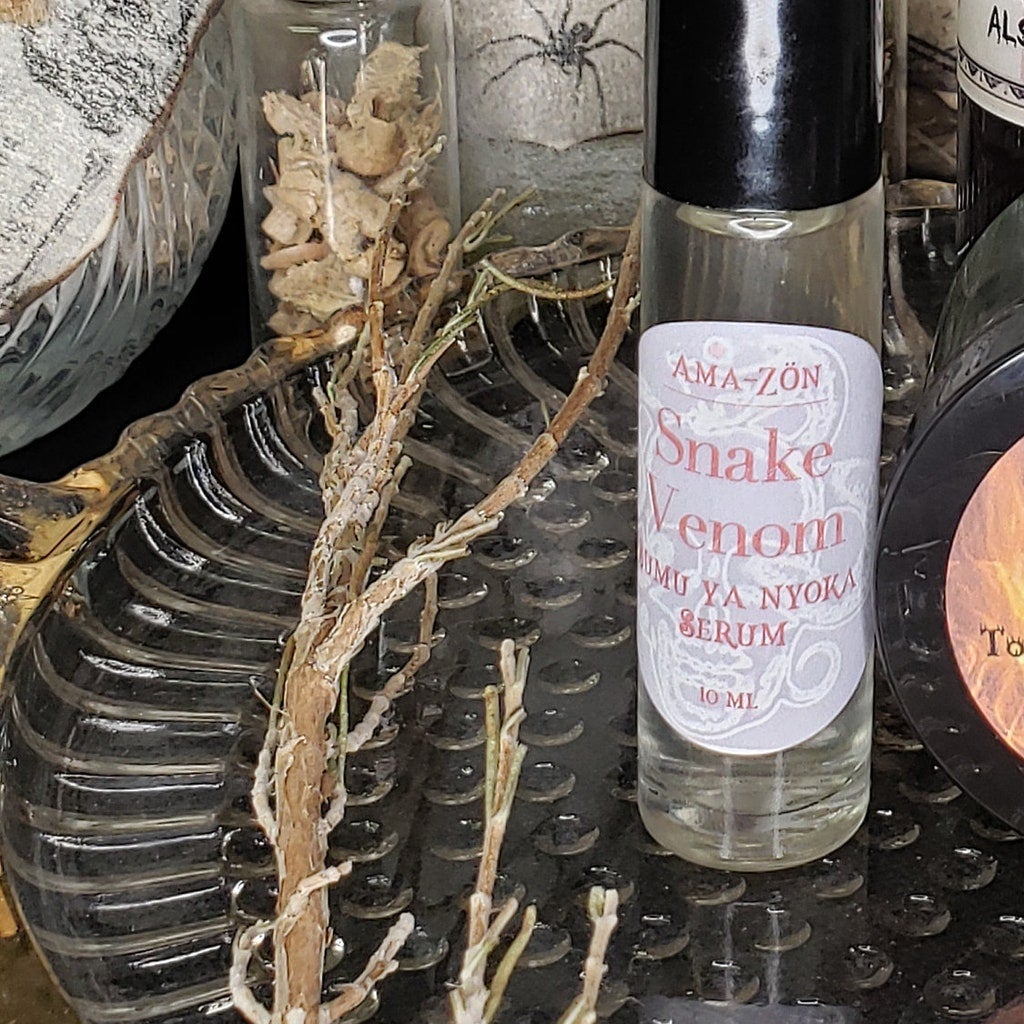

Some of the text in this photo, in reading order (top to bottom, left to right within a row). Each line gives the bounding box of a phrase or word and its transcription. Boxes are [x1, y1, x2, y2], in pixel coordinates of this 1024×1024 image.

[672, 354, 821, 396] AMA-ZÖN
[655, 407, 833, 484] Snake
[648, 472, 847, 558] Venom
[702, 579, 747, 610] YA
[759, 567, 858, 611] NYOKA
[679, 608, 789, 650] SERUM
[979, 623, 1024, 659] To
[699, 686, 758, 710] 10 ML
